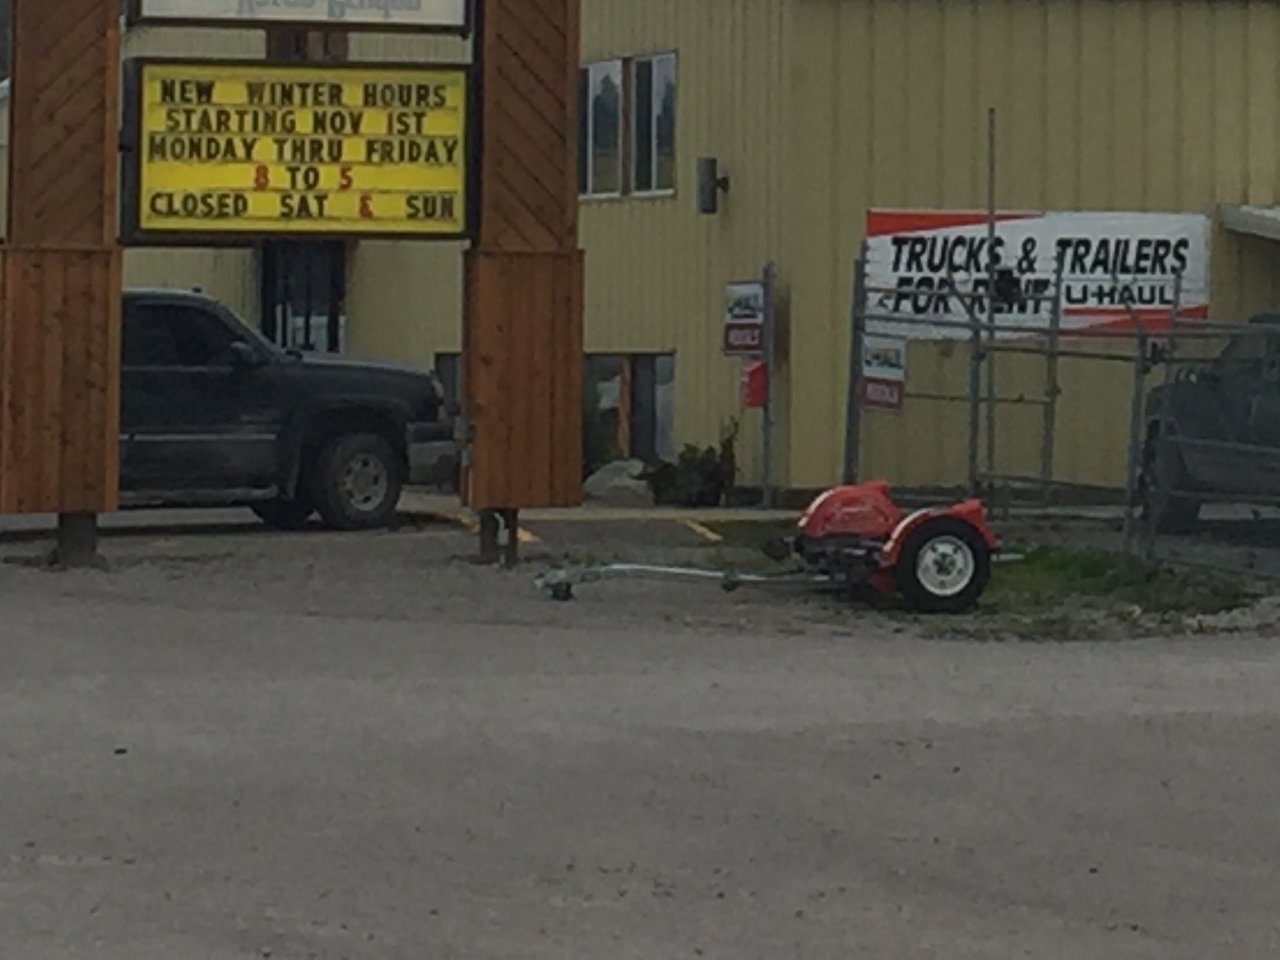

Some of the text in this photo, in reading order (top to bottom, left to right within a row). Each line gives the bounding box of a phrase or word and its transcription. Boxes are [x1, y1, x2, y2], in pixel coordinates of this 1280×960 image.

[160, 80, 447, 108] NEW WINTER HOURS
[166, 111, 296, 135] STARTING
[312, 113, 363, 135] NOV
[150, 137, 459, 163] MONDAY THRU FRIDAY
[254, 166, 354, 192] 8 TO 5
[150, 193, 455, 219] CLOSED SAT & SUN
[890, 235, 1190, 276] TRUCKS & TRAILERS
[893, 276, 955, 315] FOR
[1064, 284, 1175, 306] U-HAUL
